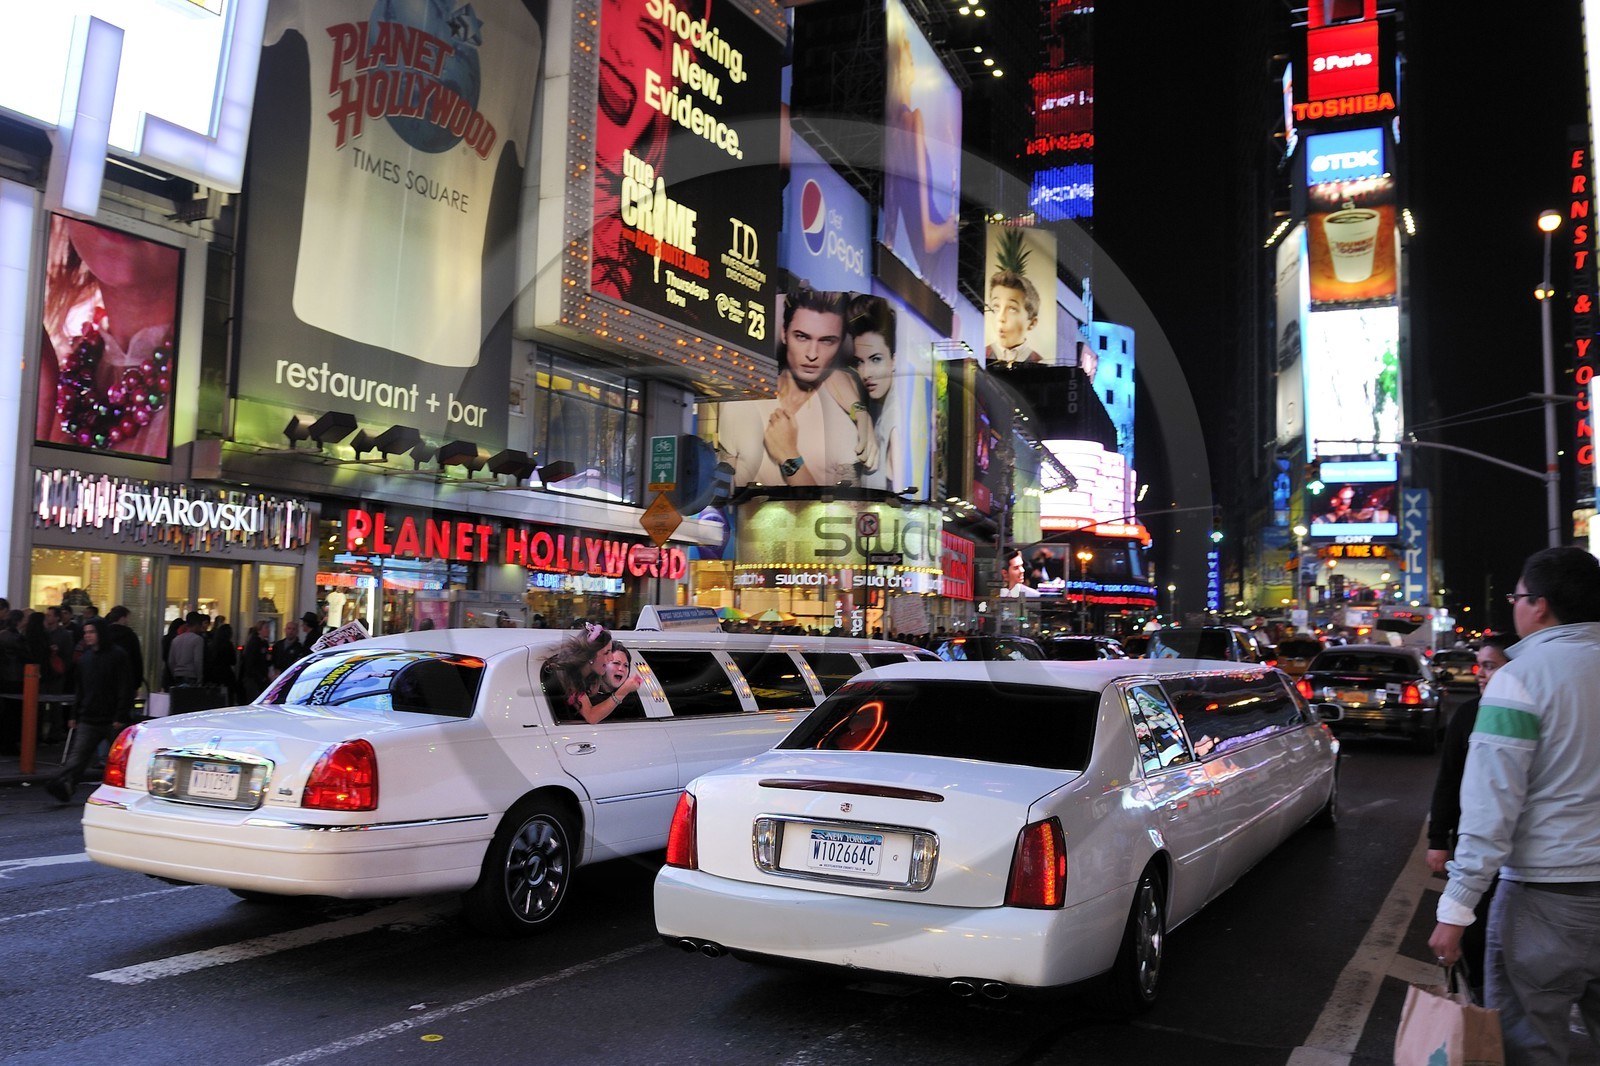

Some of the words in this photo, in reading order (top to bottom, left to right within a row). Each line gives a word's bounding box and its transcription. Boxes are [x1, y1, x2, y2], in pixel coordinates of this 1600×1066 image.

[325, 21, 456, 94] PLANET
[672, 43, 722, 105] New.
[1312, 56, 1325, 72] 3
[1326, 52, 1372, 71] Ports
[326, 71, 498, 160] HOLLYWOOD
[644, 68, 743, 160] Evidence.
[1293, 92, 1395, 121] TOSHIBA
[623, 149, 655, 188] true
[1331, 149, 1379, 171] TDK
[353, 147, 401, 184] TIMES
[405, 170, 470, 214] SQUARE
[1570, 150, 1589, 270] ERNST
[729, 217, 759, 265] ID
[826, 228, 865, 278] pepsi
[665, 269, 710, 301] Thursdays
[1573, 294, 1592, 314] &
[747, 310, 766, 341] 23
[275, 359, 418, 413] restaurant
[447, 392, 488, 428] bar
[118, 492, 260, 533] SWAROVSKI
[346, 508, 493, 563] PLANET
[506, 528, 687, 580] HOLLYWOOD
[775, 572, 829, 586] swatch
[853, 574, 905, 588] swach
[813, 840, 875, 866] W102664C
[826, 832, 844, 842] NEW
[845, 834, 865, 844] YORK
